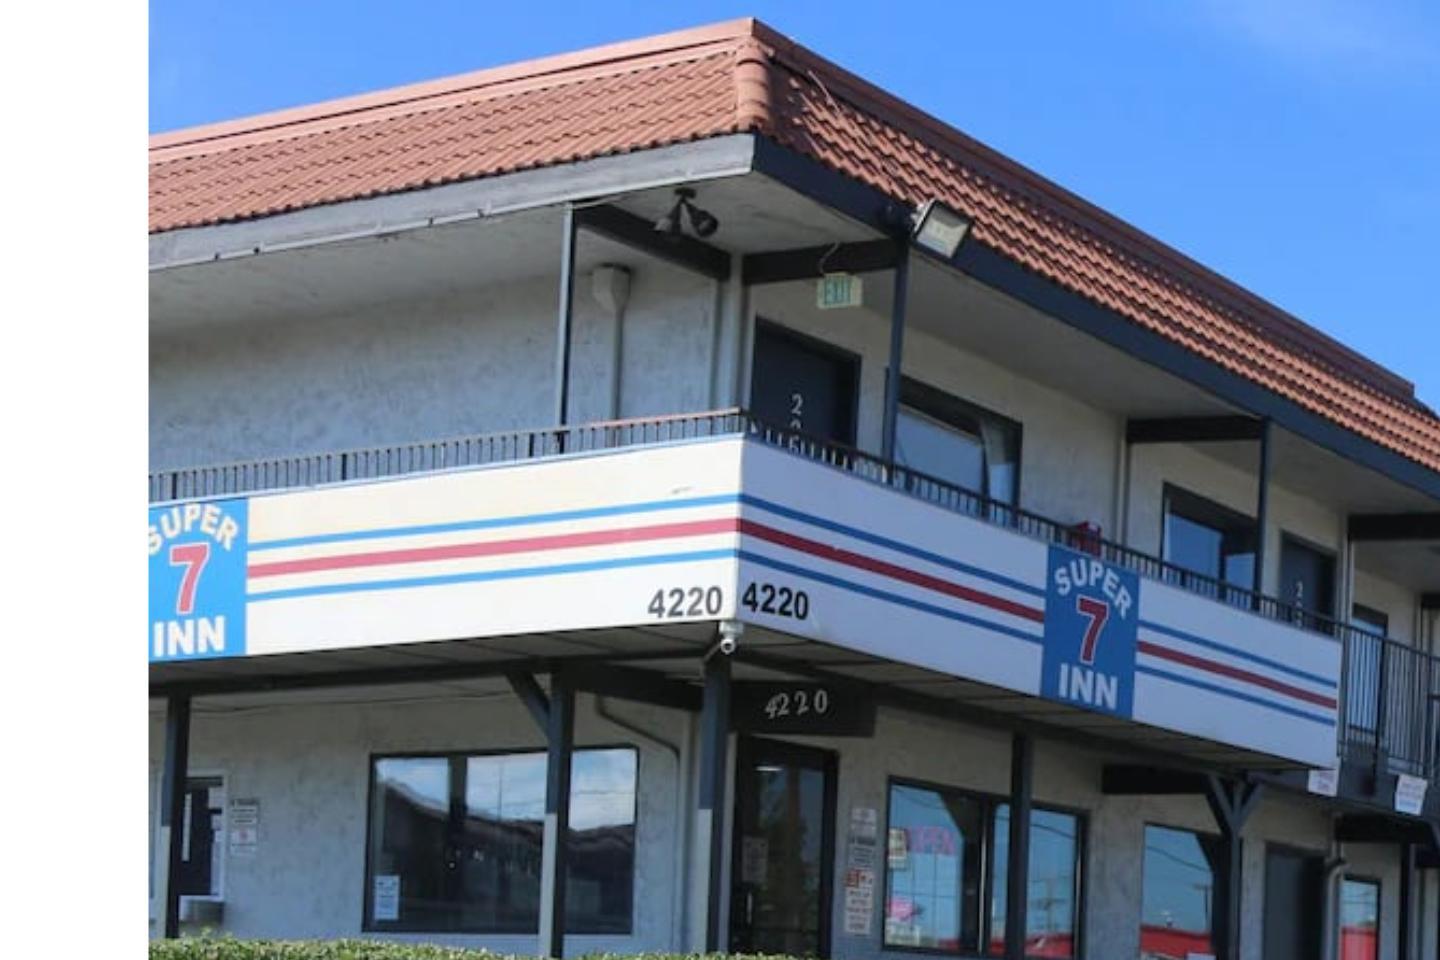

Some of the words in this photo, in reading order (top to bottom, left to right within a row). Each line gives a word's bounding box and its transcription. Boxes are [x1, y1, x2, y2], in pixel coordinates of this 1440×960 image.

[149, 503, 239, 551] SUPER
[169, 542, 210, 615] 7
[648, 586, 723, 619] 4220
[742, 582, 809, 620] 4220
[1054, 559, 1132, 619] SUPER
[153, 614, 226, 658] INN
[1076, 593, 1110, 666] 7
[765, 689, 829, 720] 4220
[1058, 662, 1118, 711] INN
